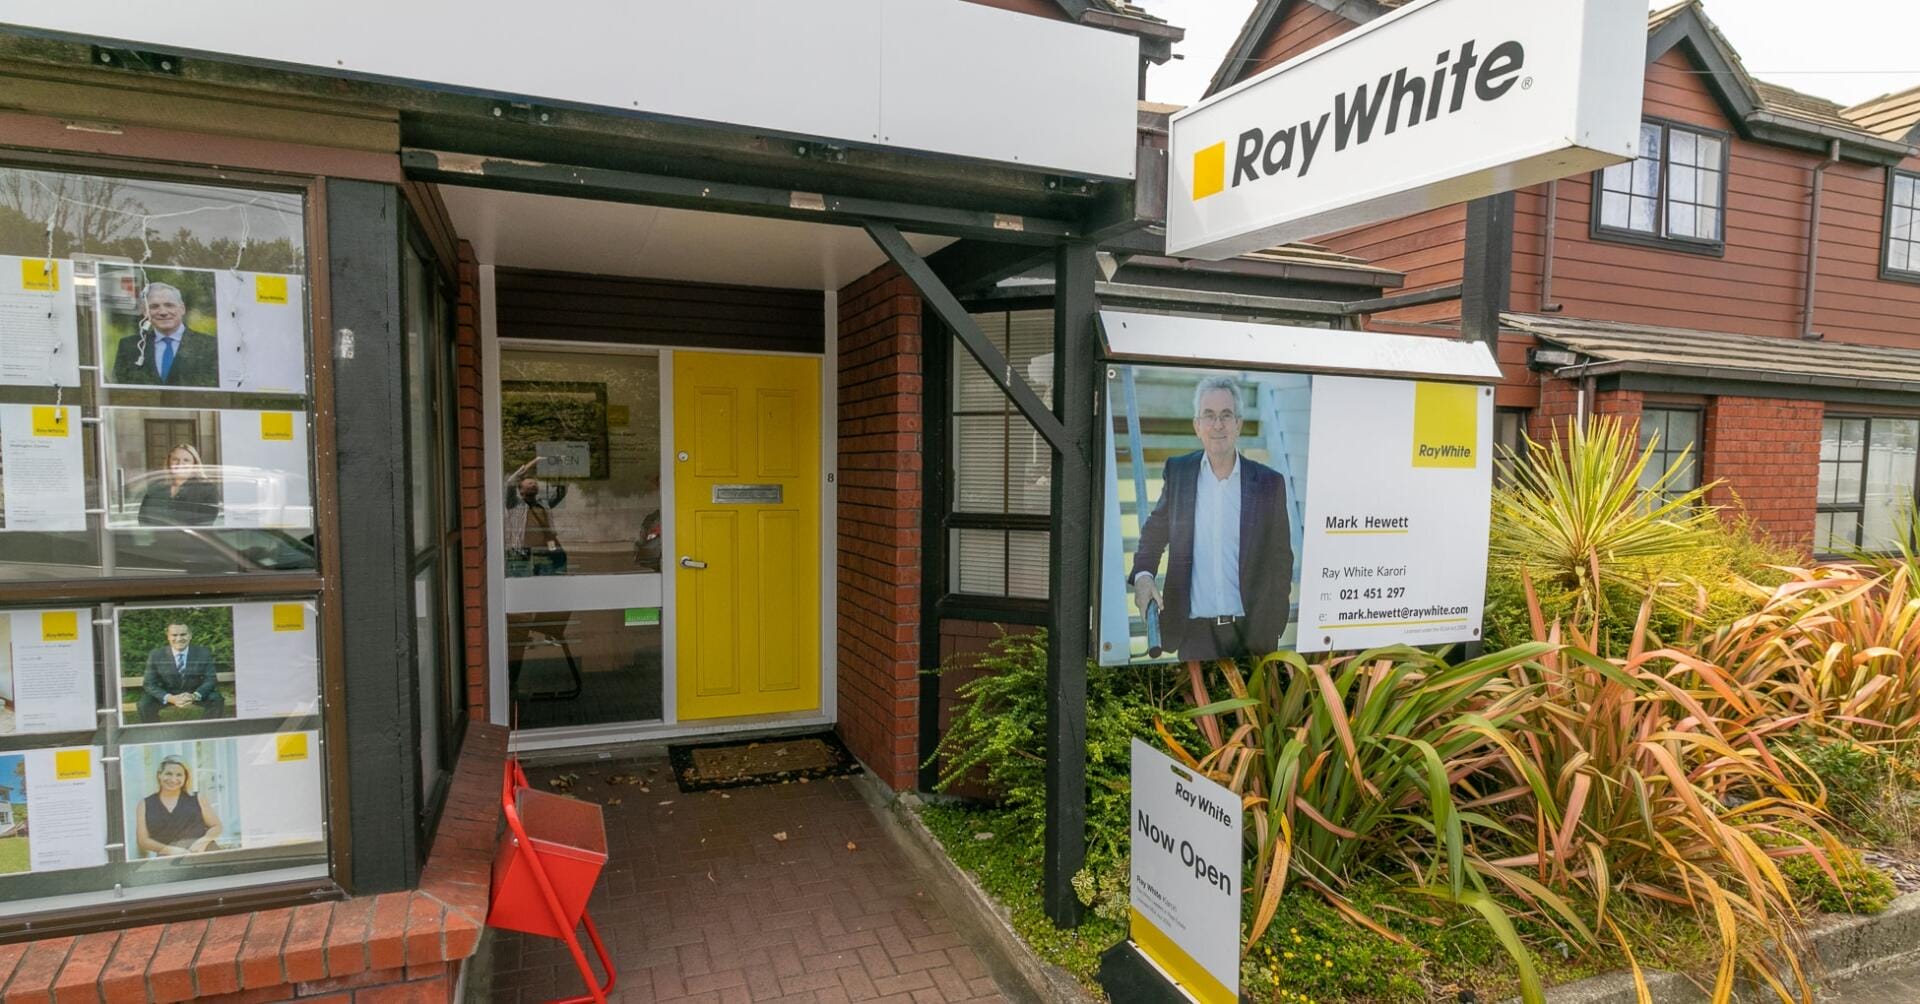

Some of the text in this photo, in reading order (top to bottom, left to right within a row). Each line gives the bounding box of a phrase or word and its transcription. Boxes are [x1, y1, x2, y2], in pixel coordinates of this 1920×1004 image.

[827, 472, 834, 483] 8
[1325, 515, 1409, 530] Mark Hewett
[1321, 565, 1407, 580] Ray White Karori
[1340, 588, 1359, 600] 021
[1363, 587, 1382, 599] 451
[1386, 587, 1406, 599] 297
[1338, 604, 1469, 622] mark.hewett@raywhite.com
[1137, 808, 1232, 897] Now Open
[1136, 874, 1147, 890] Ray
[1146, 882, 1162, 902] White
